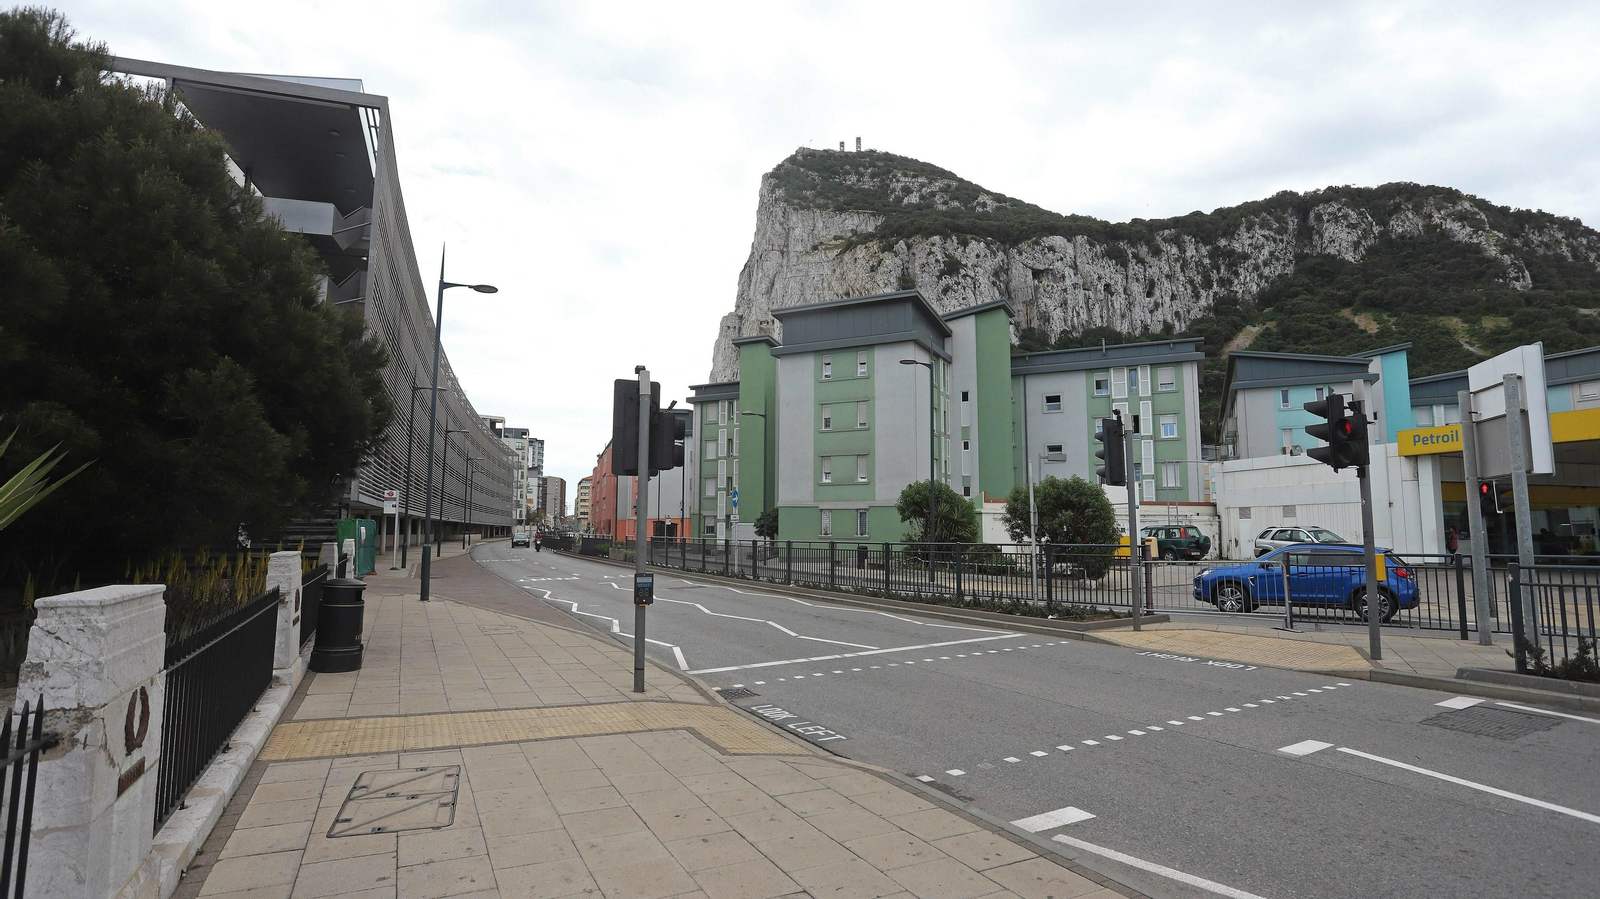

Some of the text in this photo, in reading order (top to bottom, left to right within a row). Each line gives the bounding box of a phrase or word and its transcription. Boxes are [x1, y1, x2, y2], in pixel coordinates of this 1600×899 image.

[1413, 429, 1459, 446] Petroil
[1135, 651, 1258, 671] LOOK RIGHT
[751, 704, 847, 741] LOOK LEFT
